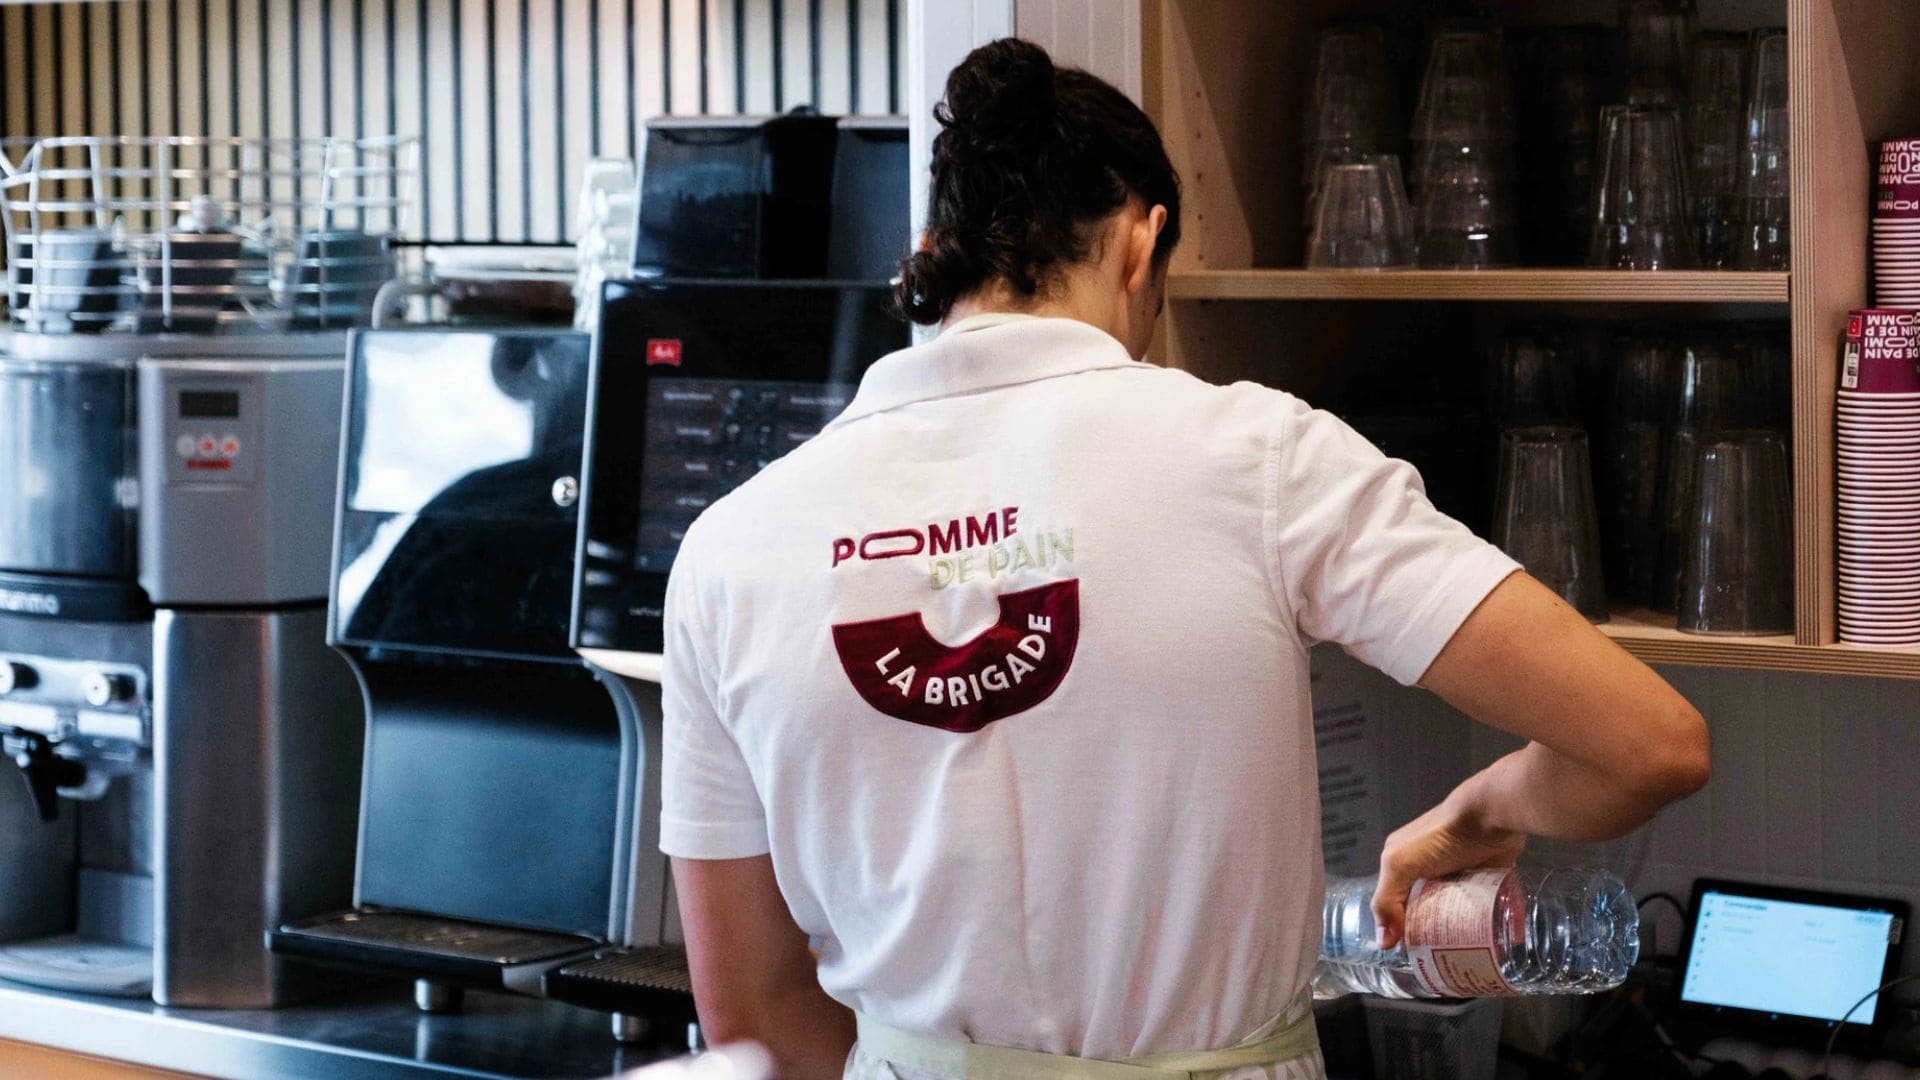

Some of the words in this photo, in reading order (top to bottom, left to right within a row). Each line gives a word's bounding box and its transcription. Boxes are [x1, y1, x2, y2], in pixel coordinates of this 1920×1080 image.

[1865, 348, 1903, 359] PAIN
[1879, 326, 1898, 336] DE
[832, 507, 1019, 568] POMME
[929, 555, 976, 591] DE
[988, 528, 1075, 579] PAIN
[875, 647, 917, 697] LA
[925, 614, 1052, 707] BRIGADE
